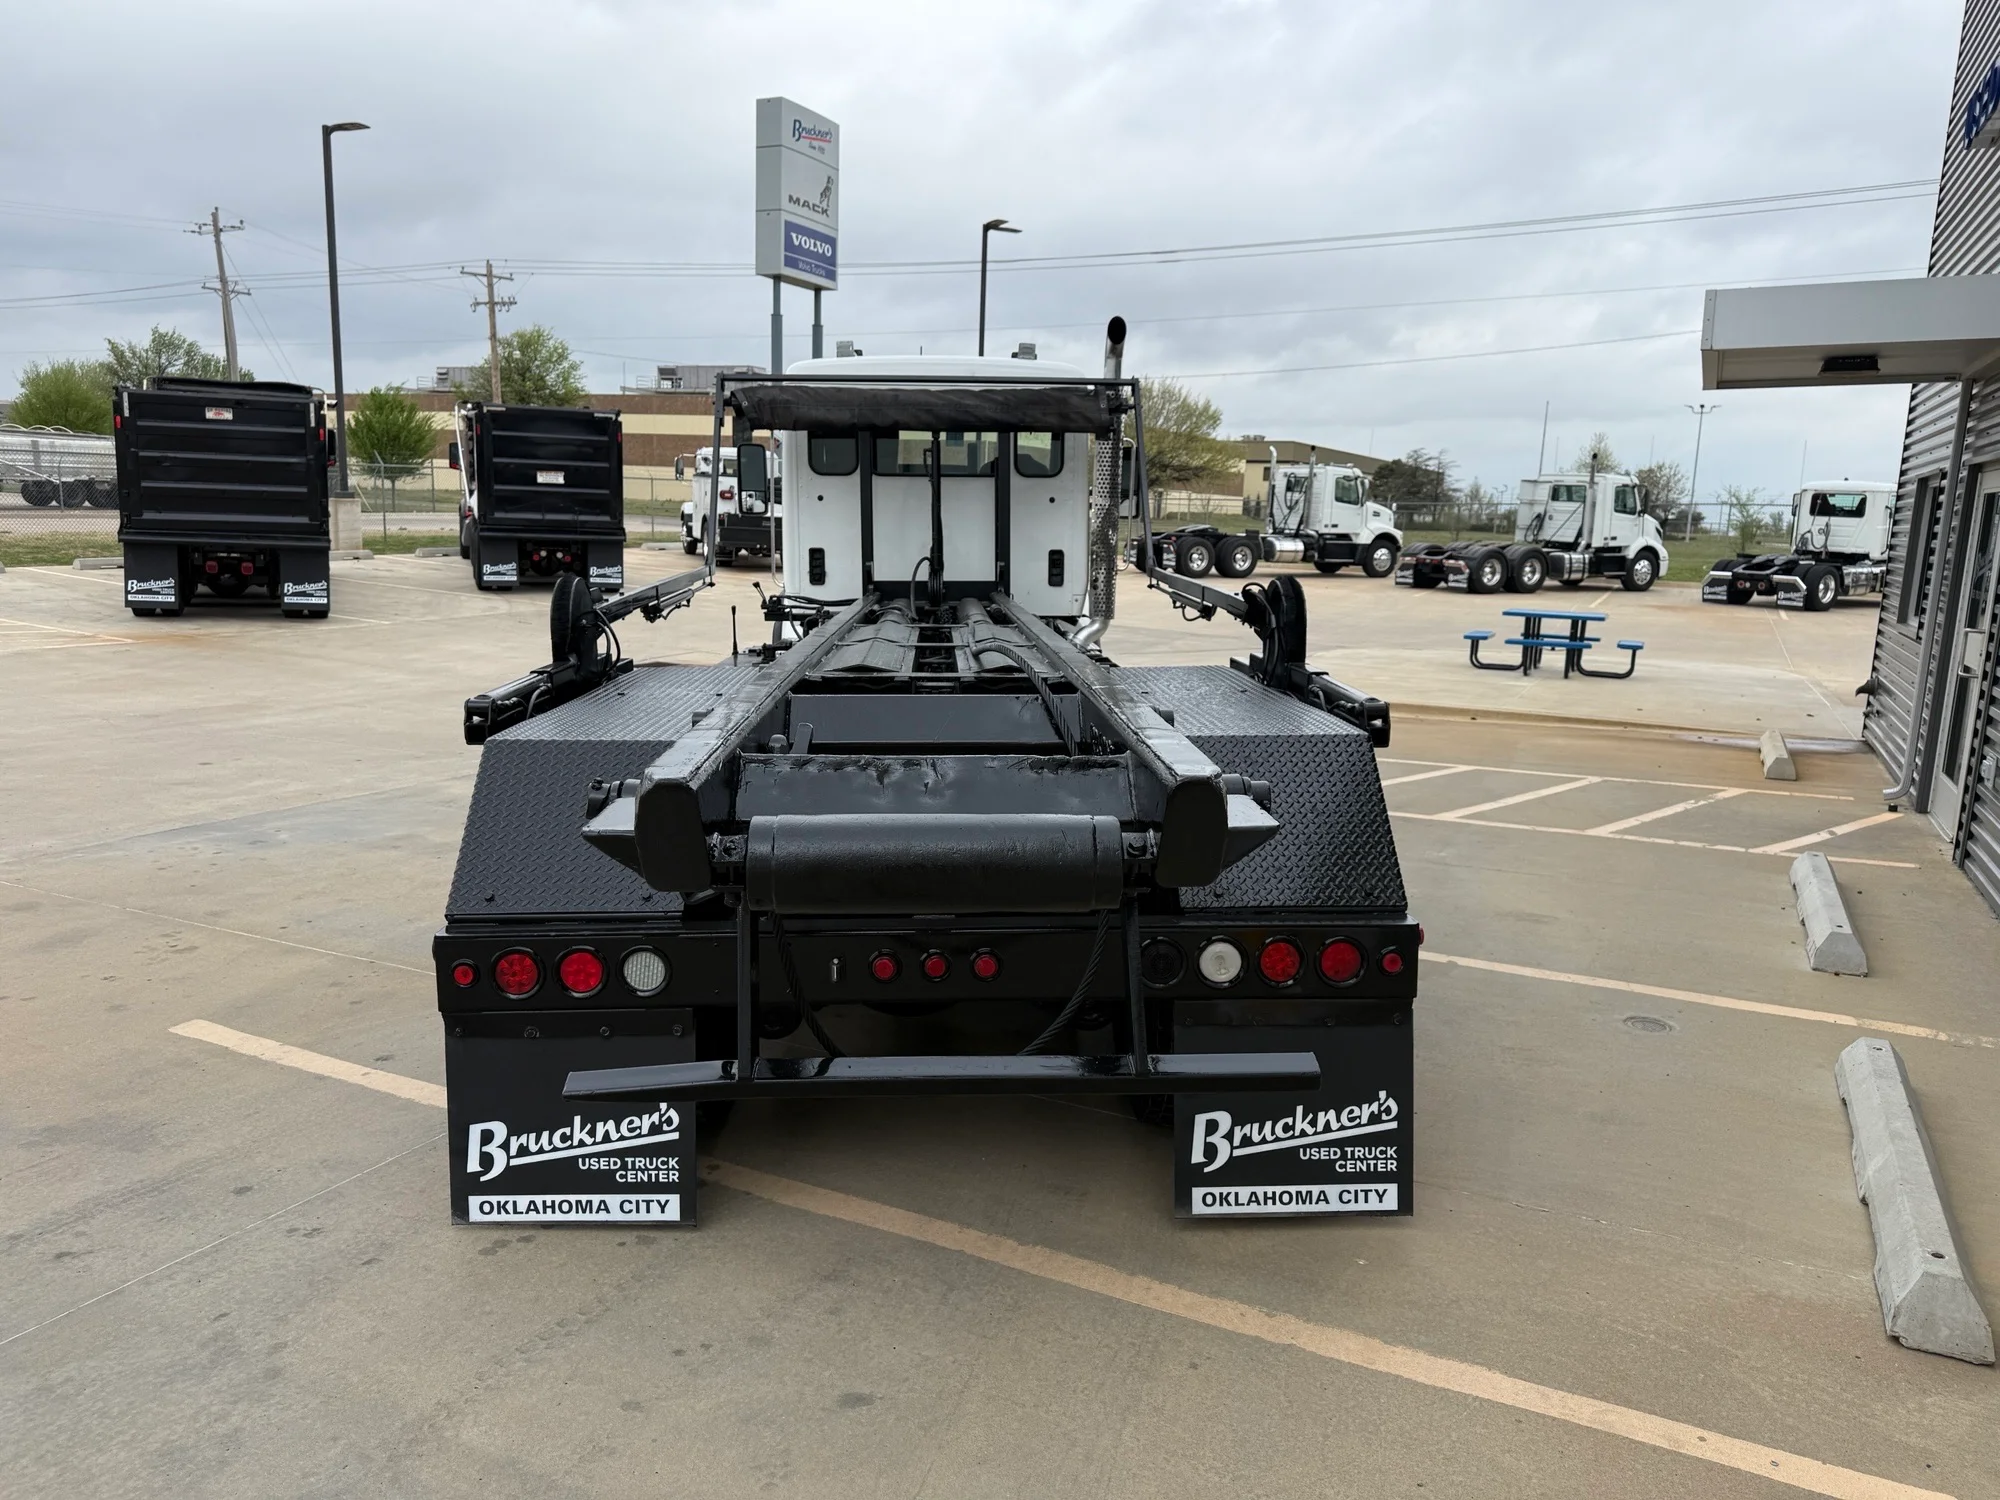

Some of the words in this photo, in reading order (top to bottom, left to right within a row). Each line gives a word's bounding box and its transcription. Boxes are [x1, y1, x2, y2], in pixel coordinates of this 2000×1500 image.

[792, 118, 833, 142] Bruckner's
[788, 194, 830, 218] MACK
[790, 231, 832, 257] VOLVO
[127, 577, 175, 593] Bruckner's
[1191, 1090, 1399, 1173] Bruckner's
[466, 1102, 680, 1182] Bruckner's
[1300, 1148, 1341, 1160] USED
[1345, 1146, 1398, 1159] TRUCK
[578, 1157, 621, 1170] USED
[624, 1157, 680, 1170] TRUCK
[1335, 1160, 1398, 1173] CENTER
[615, 1170, 680, 1183] CENTER
[478, 1199, 611, 1215] OKLAHOMA
[619, 1198, 671, 1214] CITY
[1201, 1190, 1331, 1207] OKLAHOMA
[1338, 1188, 1389, 1205] CITY
